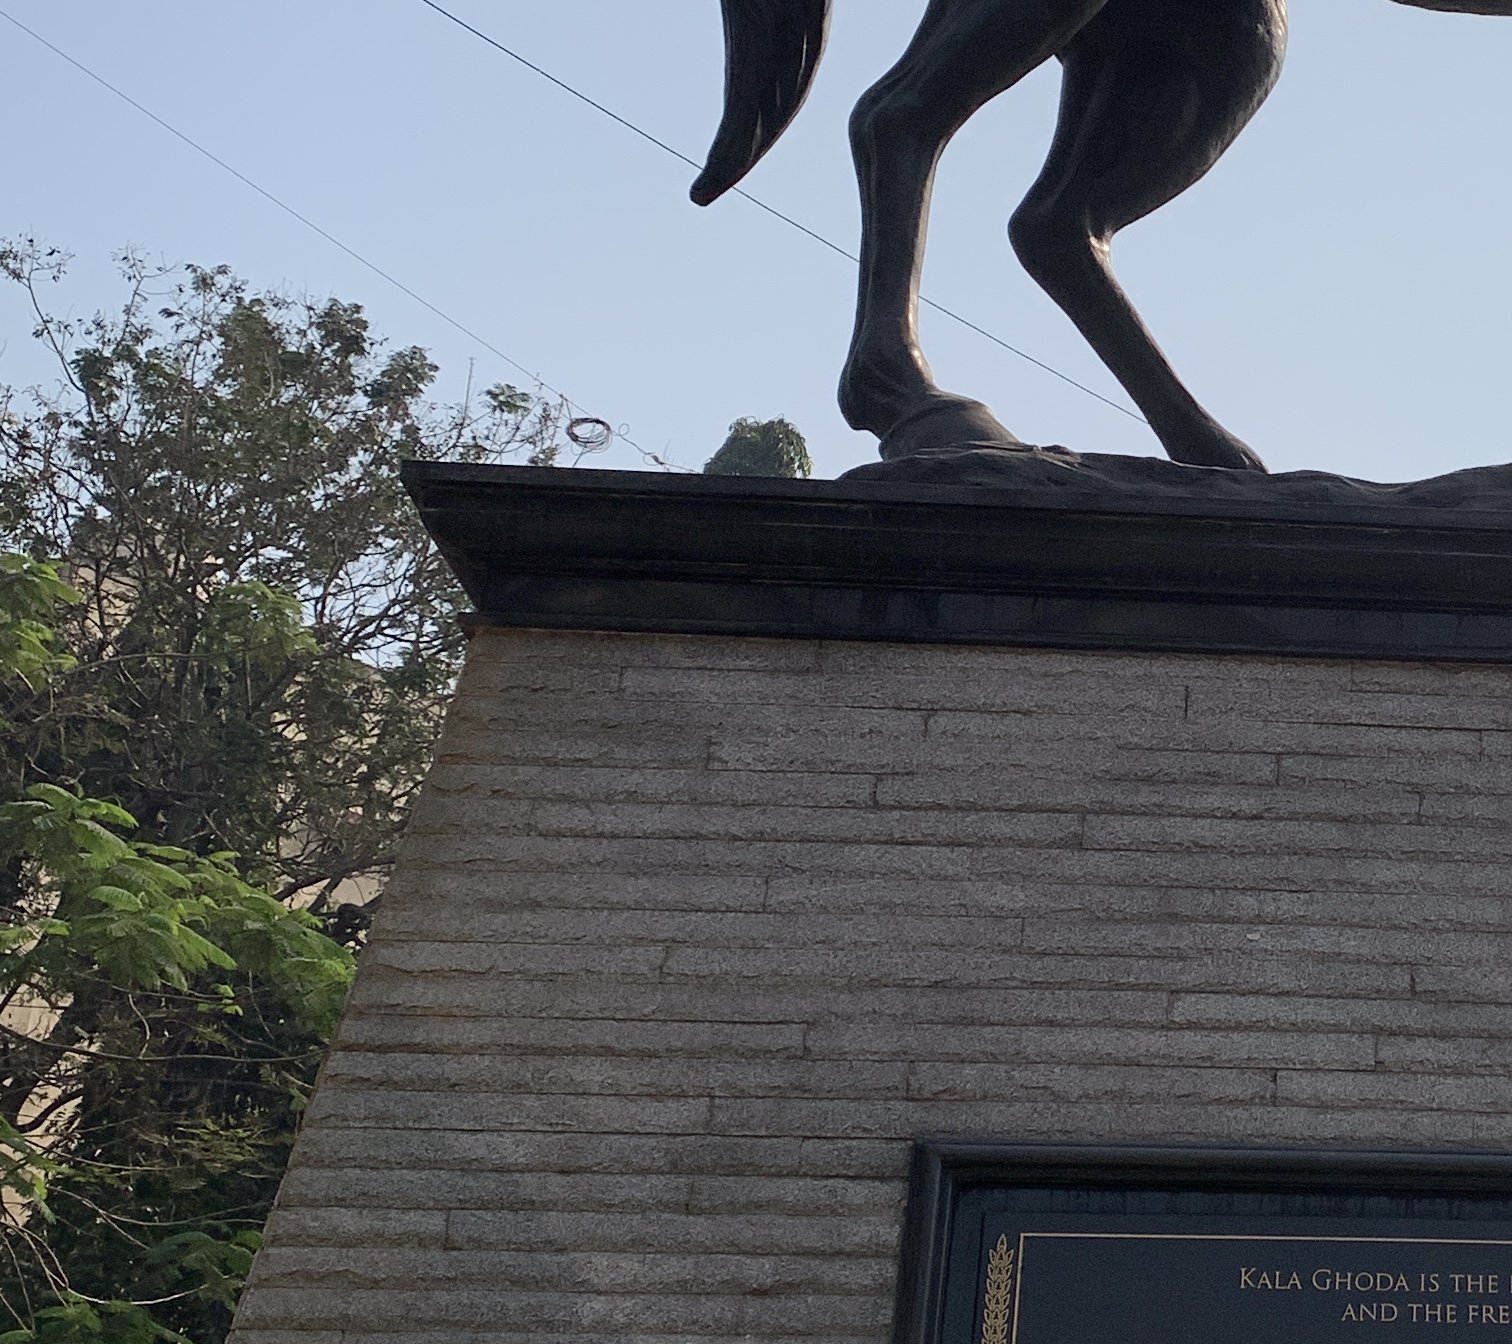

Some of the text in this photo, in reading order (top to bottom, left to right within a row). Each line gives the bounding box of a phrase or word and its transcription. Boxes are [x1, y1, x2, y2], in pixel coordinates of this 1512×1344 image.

[1239, 1267, 1303, 1290] KALA
[1312, 1268, 1410, 1292] GHODA
[1419, 1273, 1440, 1293] IS
[1448, 1273, 1499, 1294] THE
[1341, 1302, 1398, 1322] AND
[1407, 1303, 1457, 1324] THE
